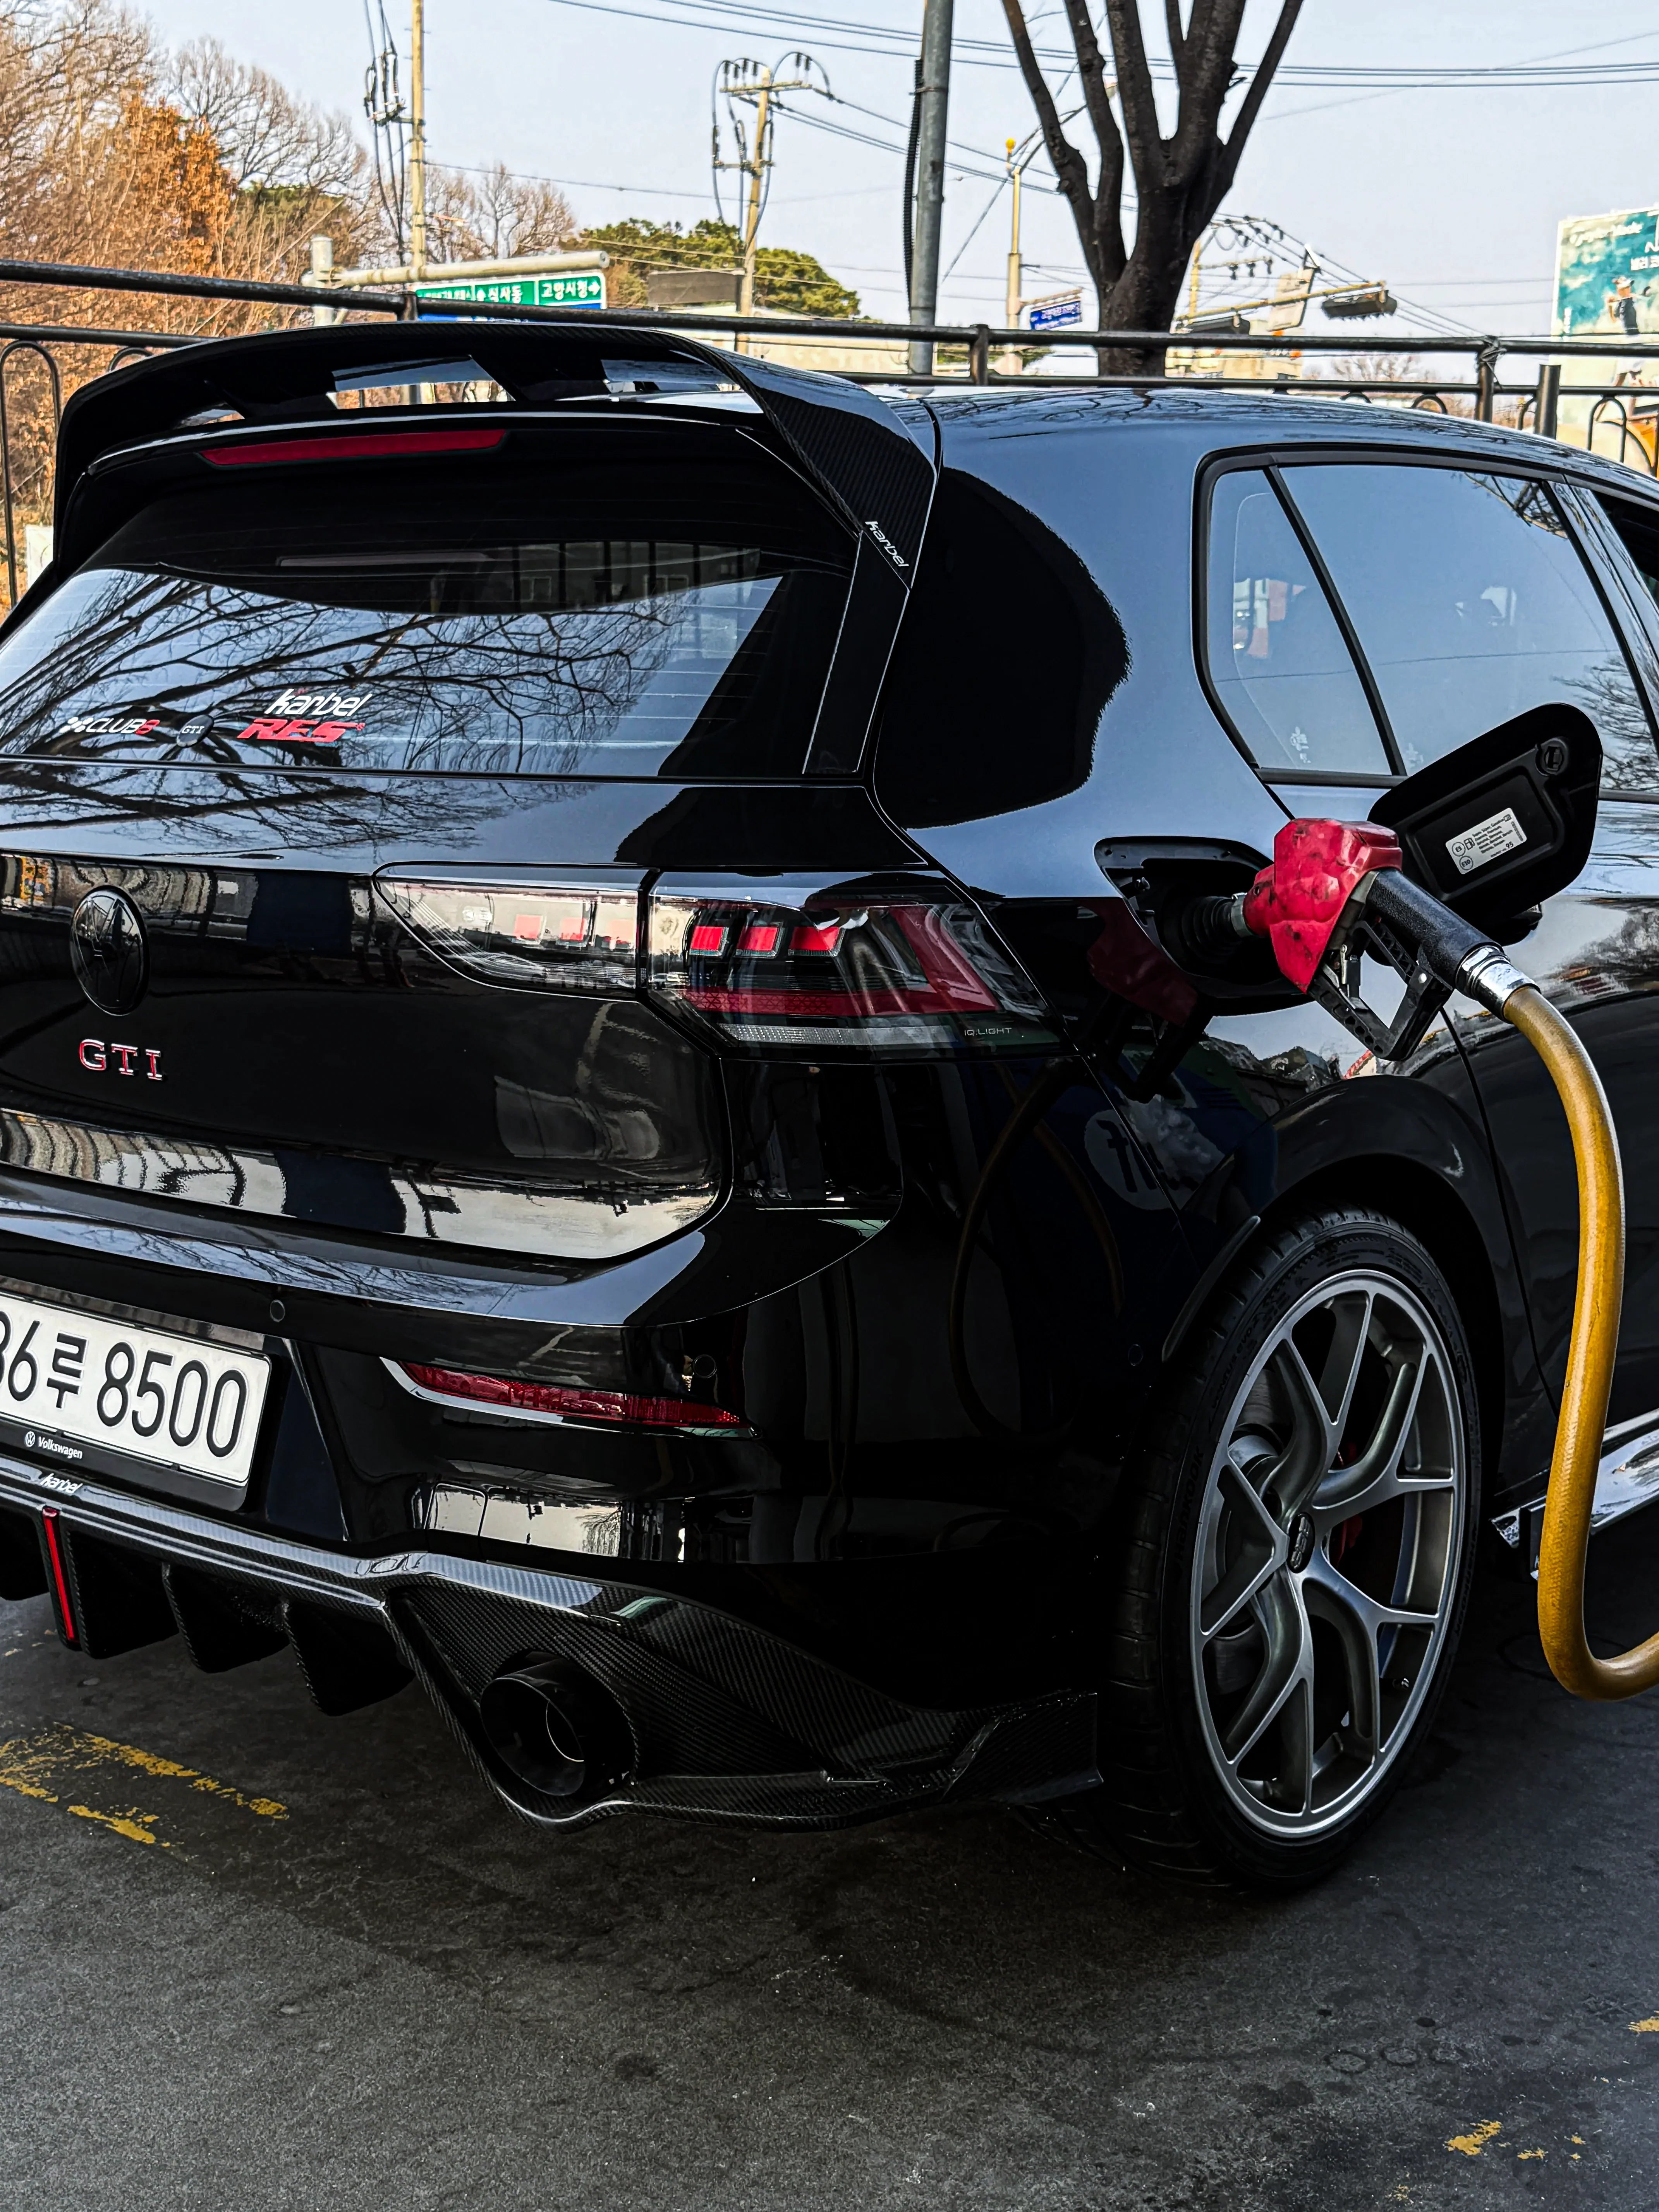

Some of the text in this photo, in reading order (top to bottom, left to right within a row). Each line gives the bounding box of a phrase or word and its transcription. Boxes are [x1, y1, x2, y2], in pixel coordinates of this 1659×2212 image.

[488, 285, 522, 304] 식사동
[541, 280, 587, 300] 고양시청
[865, 521, 909, 567] karbel
[264, 689, 373, 716] karbel
[86, 718, 160, 735] CLUB8
[182, 725, 204, 734] GTI
[964, 1027, 1012, 1036] IQ.LIGHT
[79, 1039, 163, 1080] GTI
[97, 1342, 247, 1458] 8500
[39, 1436, 82, 1459] Volkswagen
[40, 1473, 83, 1494] karbel
